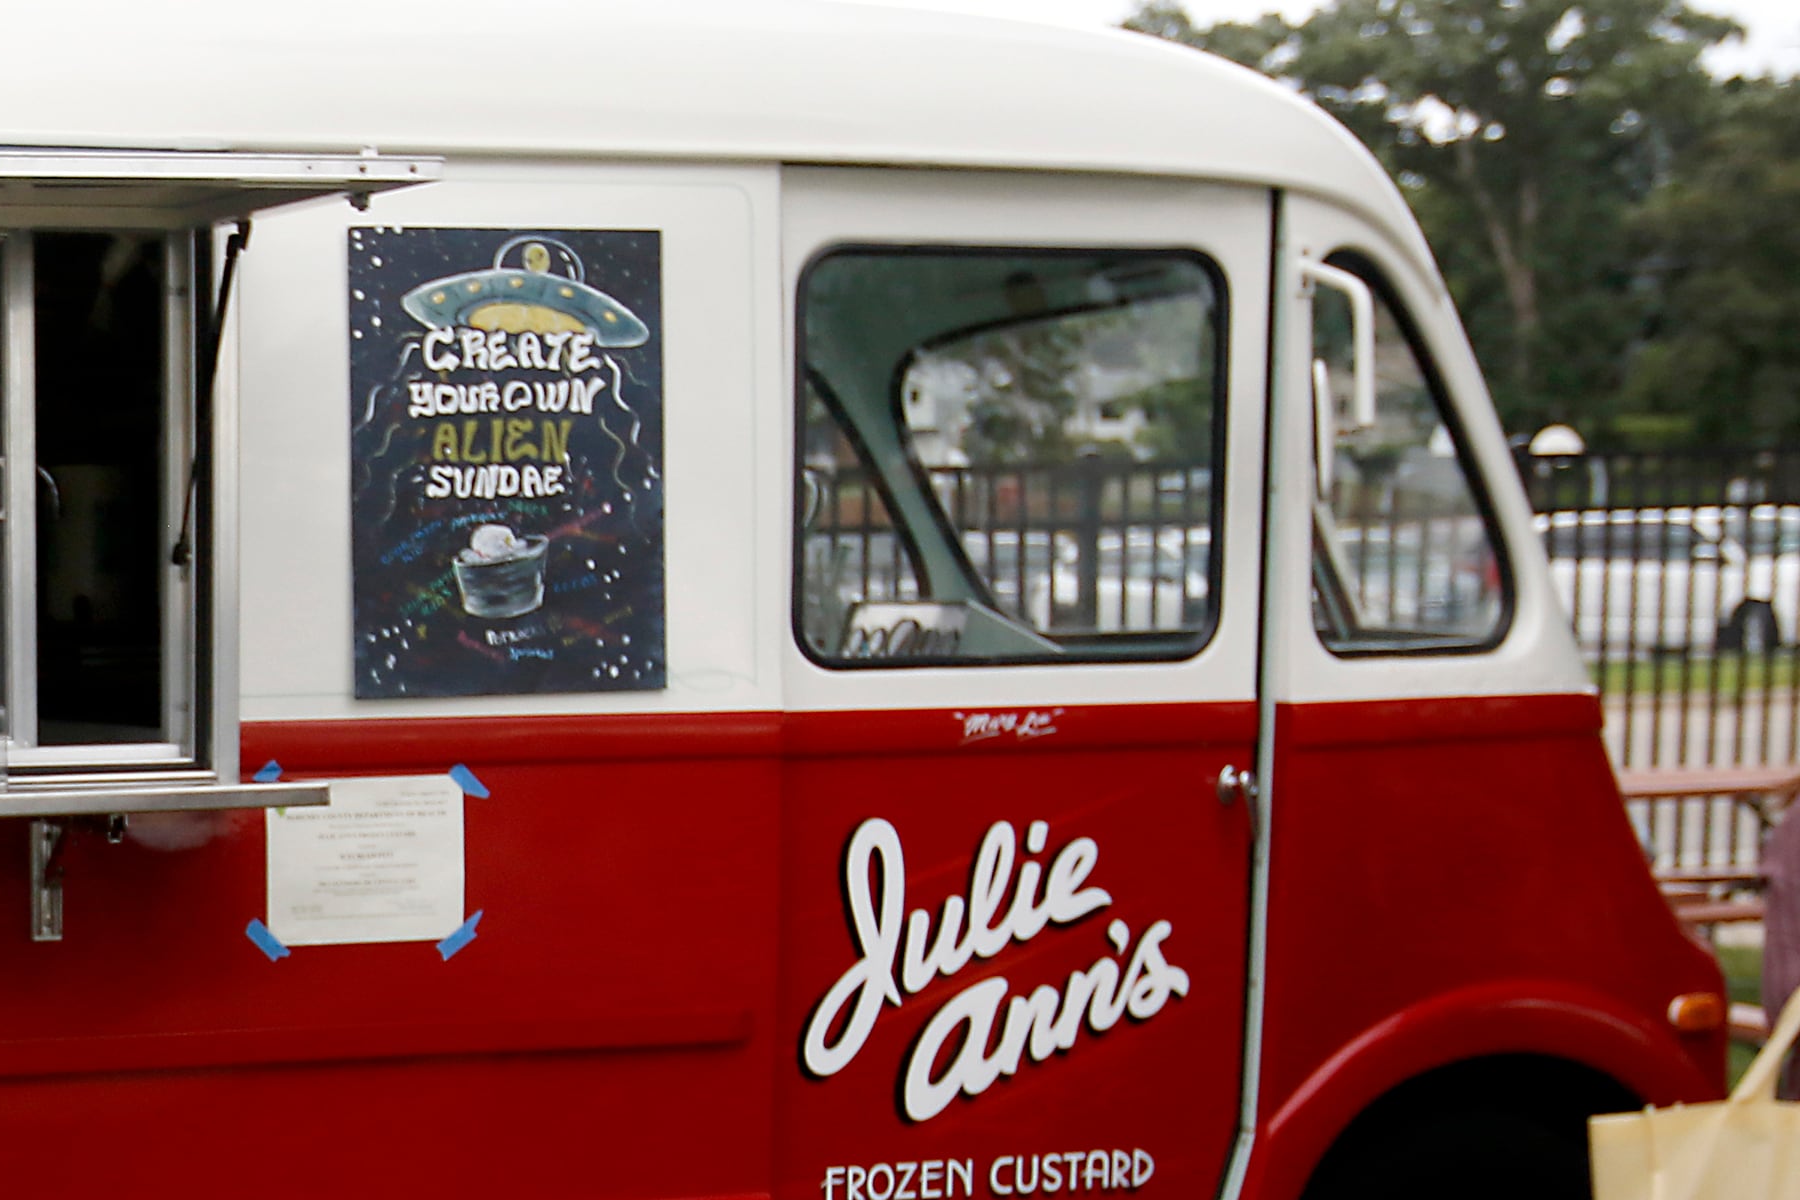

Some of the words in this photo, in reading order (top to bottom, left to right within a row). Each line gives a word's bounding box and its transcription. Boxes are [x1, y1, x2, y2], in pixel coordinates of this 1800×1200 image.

[423, 326, 604, 372] CREATE
[407, 380, 501, 418] YOUR
[502, 376, 606, 414] OWN
[432, 417, 574, 463] ALIEN
[425, 464, 566, 499] SUNDAE
[804, 817, 1112, 1077] Julie
[989, 1148, 1155, 1195] CUSTARD
